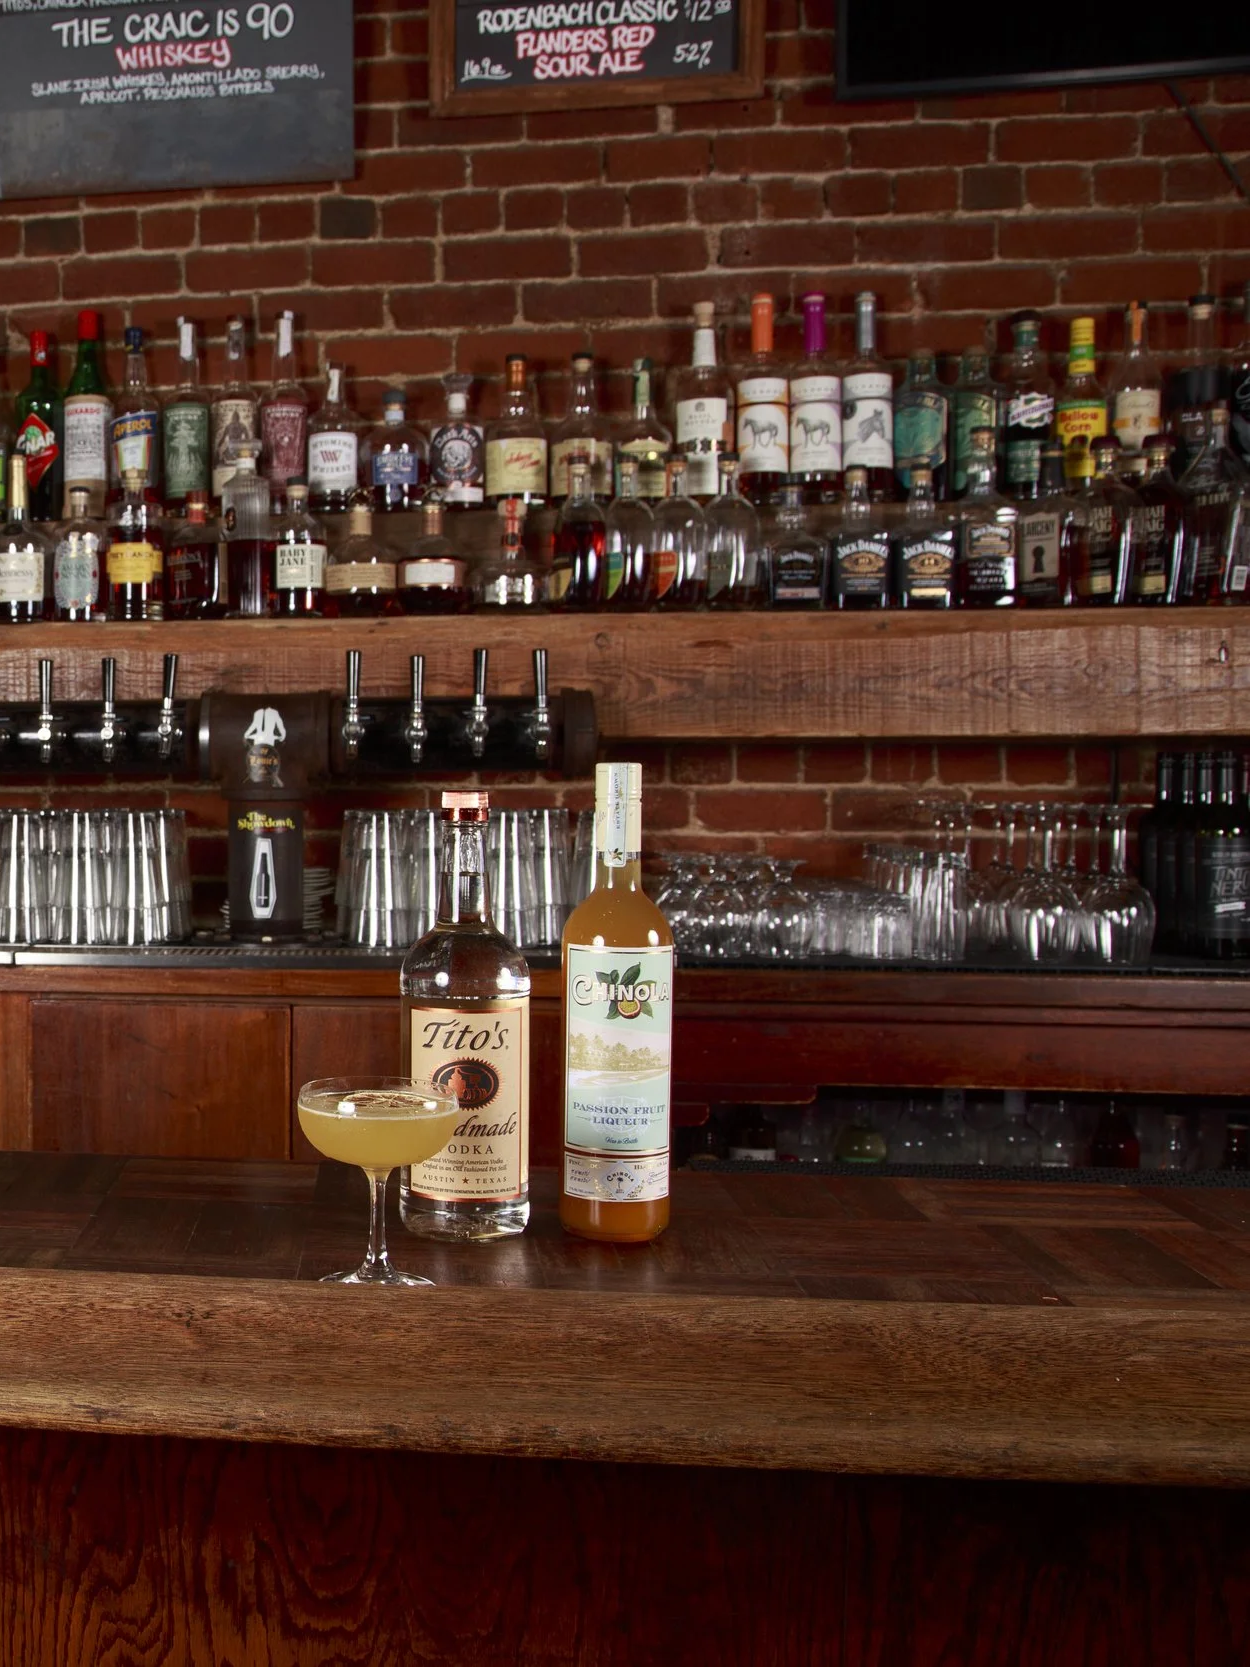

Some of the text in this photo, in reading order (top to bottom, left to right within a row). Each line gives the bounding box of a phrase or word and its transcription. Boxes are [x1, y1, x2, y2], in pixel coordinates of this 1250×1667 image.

[51, 3, 294, 47] THE CRAIC IS 90
[477, 0, 678, 34] RODENBACH CLASSIC
[515, 26, 656, 60] FLANDERS RED
[115, 39, 231, 70] WHISKEY
[533, 53, 596, 80] SOUR
[600, 50, 645, 72] ALE
[31, 79, 73, 96] SLANE
[73, 77, 110, 91] IRISH
[170, 69, 261, 88] AMONTILLADO
[219, 81, 275, 95] BITTERS
[113, 419, 152, 437] APEROL
[1064, 422, 1092, 433] Corn
[279, 549, 306, 557] BABY
[279, 558, 306, 567] JANE
[237, 817, 296, 832] Showdown
[246, 811, 267, 822] The
[572, 974, 669, 1006] CHINOLA
[422, 1019, 509, 1050] Tito's
[573, 1101, 666, 1114] PASSION FRUIT
[453, 1112, 517, 1137] dmade
[593, 1116, 648, 1126] LIQUEUR
[447, 1144, 494, 1154] ODKA
[422, 1174, 455, 1183] AUSTIN
